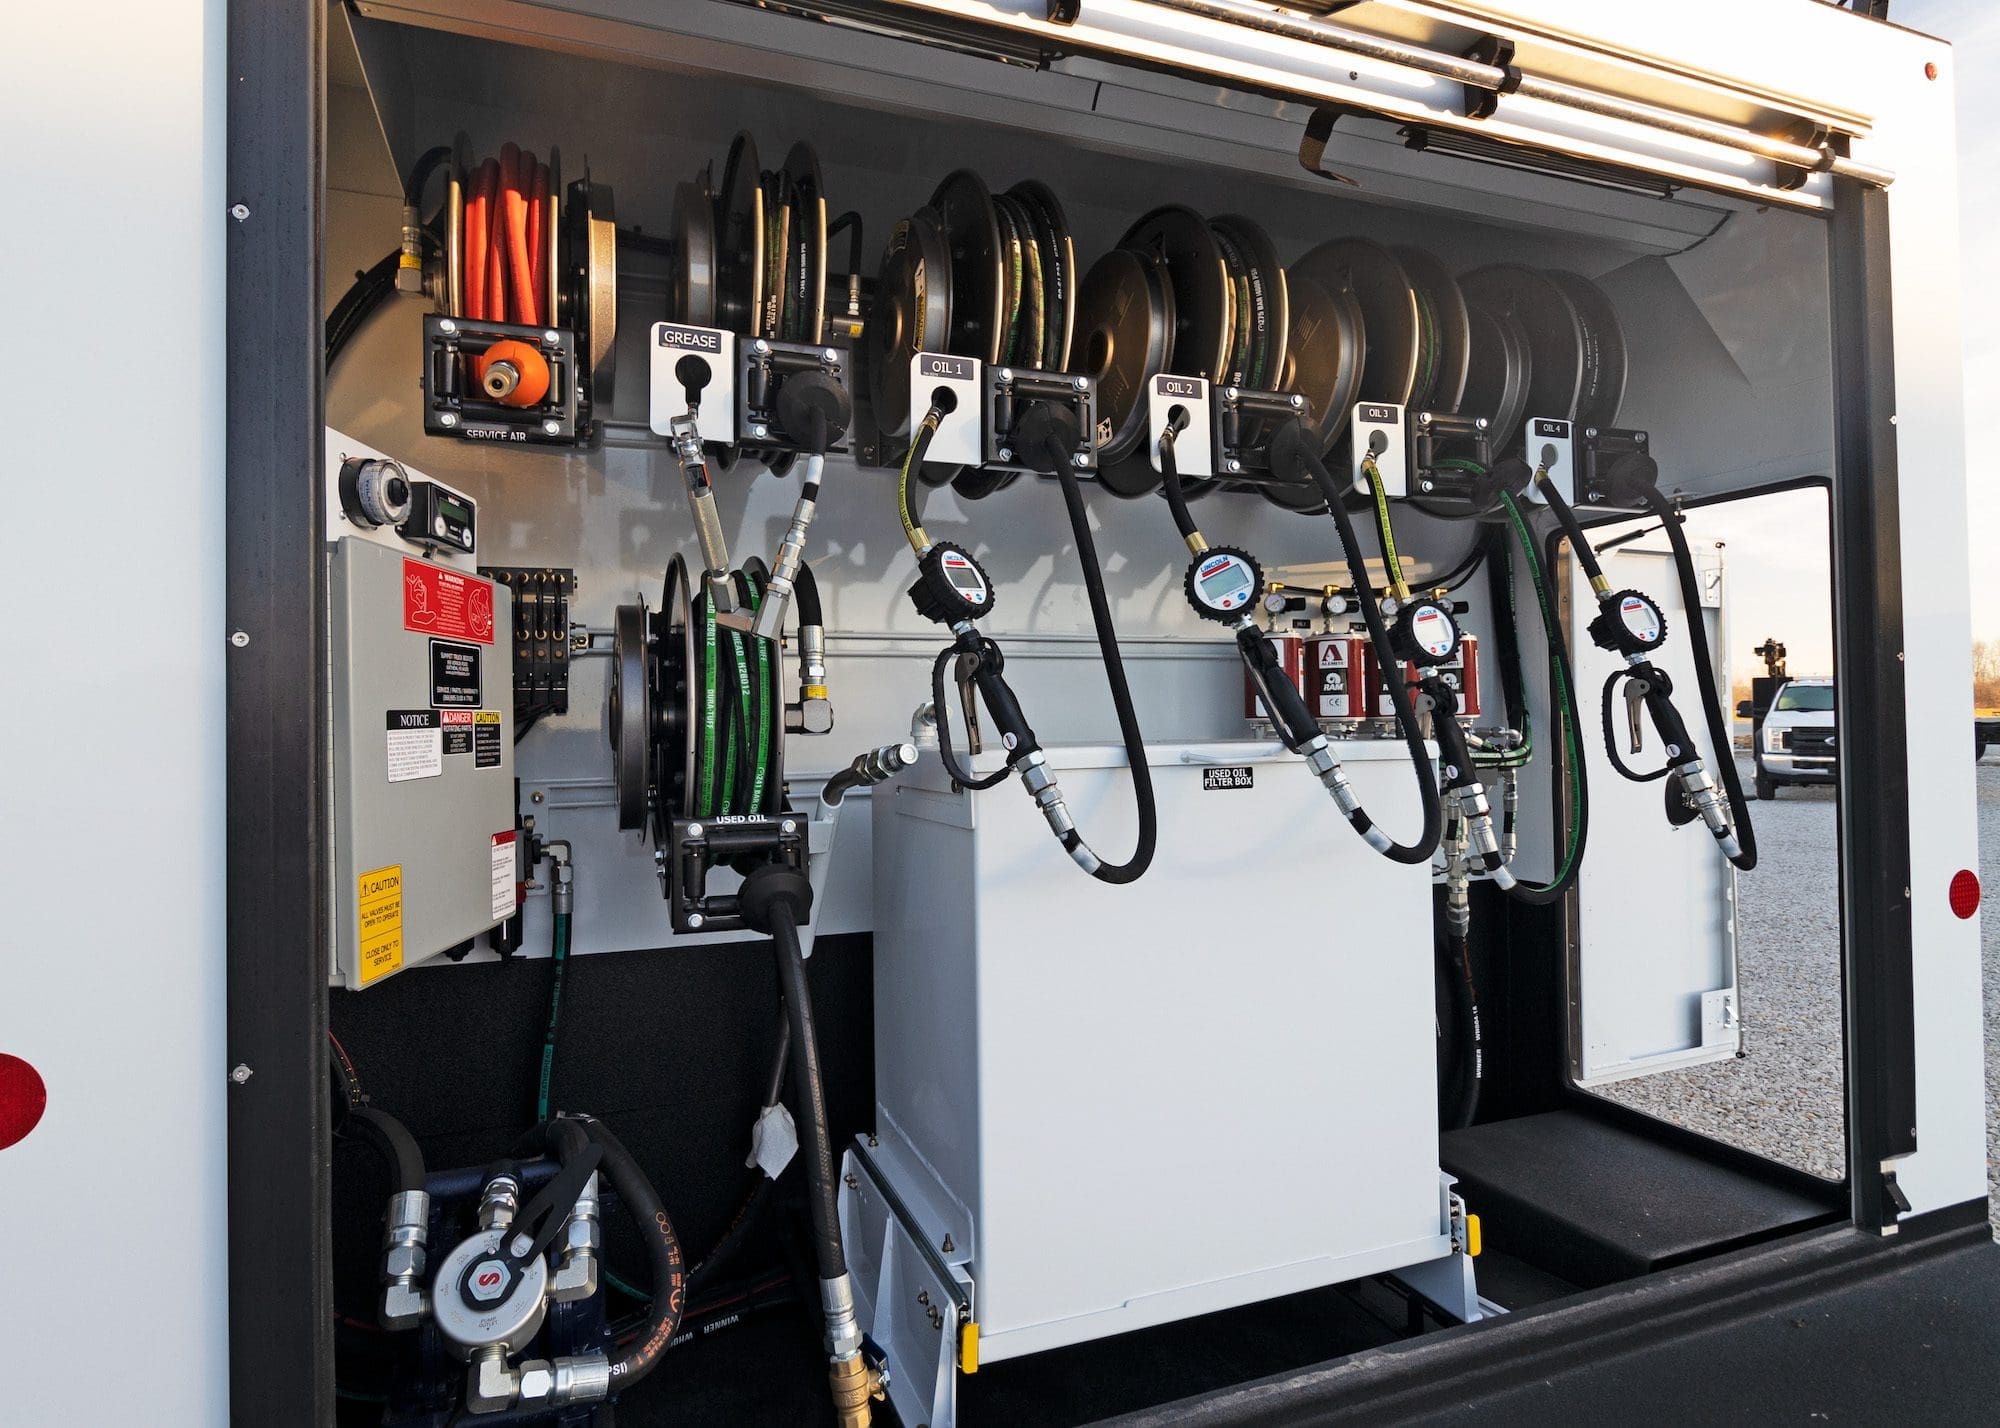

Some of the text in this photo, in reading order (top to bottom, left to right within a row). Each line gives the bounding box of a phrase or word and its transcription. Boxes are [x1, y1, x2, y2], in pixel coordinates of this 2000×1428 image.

[664, 329, 717, 350] GREASE
[931, 361, 963, 375] OIL 1
[1166, 381, 1194, 394] OIL 2
[1368, 408, 1389, 418] OIL 3
[1543, 423, 1561, 433] OIL 4
[466, 429, 527, 442] SERVICE AIR
[1200, 555, 1228, 573] LINCOLN
[738, 661, 751, 696] H28012
[1323, 683, 1344, 692] RAM
[706, 688, 715, 729] DURA-TUFF
[400, 714, 430, 727] NOTICE
[449, 713, 472, 724] DANGER
[475, 713, 500, 723] CAUTION
[1209, 768, 1247, 778] USED OIL
[1204, 776, 1252, 787] FILTER BOX
[716, 814, 767, 825] USED OIL
[370, 876, 399, 894] CAUTION
[383, 903, 394, 914] MUST
[366, 947, 380, 960] CLOSE
[380, 943, 392, 954] ONLY
[373, 952, 392, 967] SERVICE
[703, 1314, 739, 1334] WINNER
